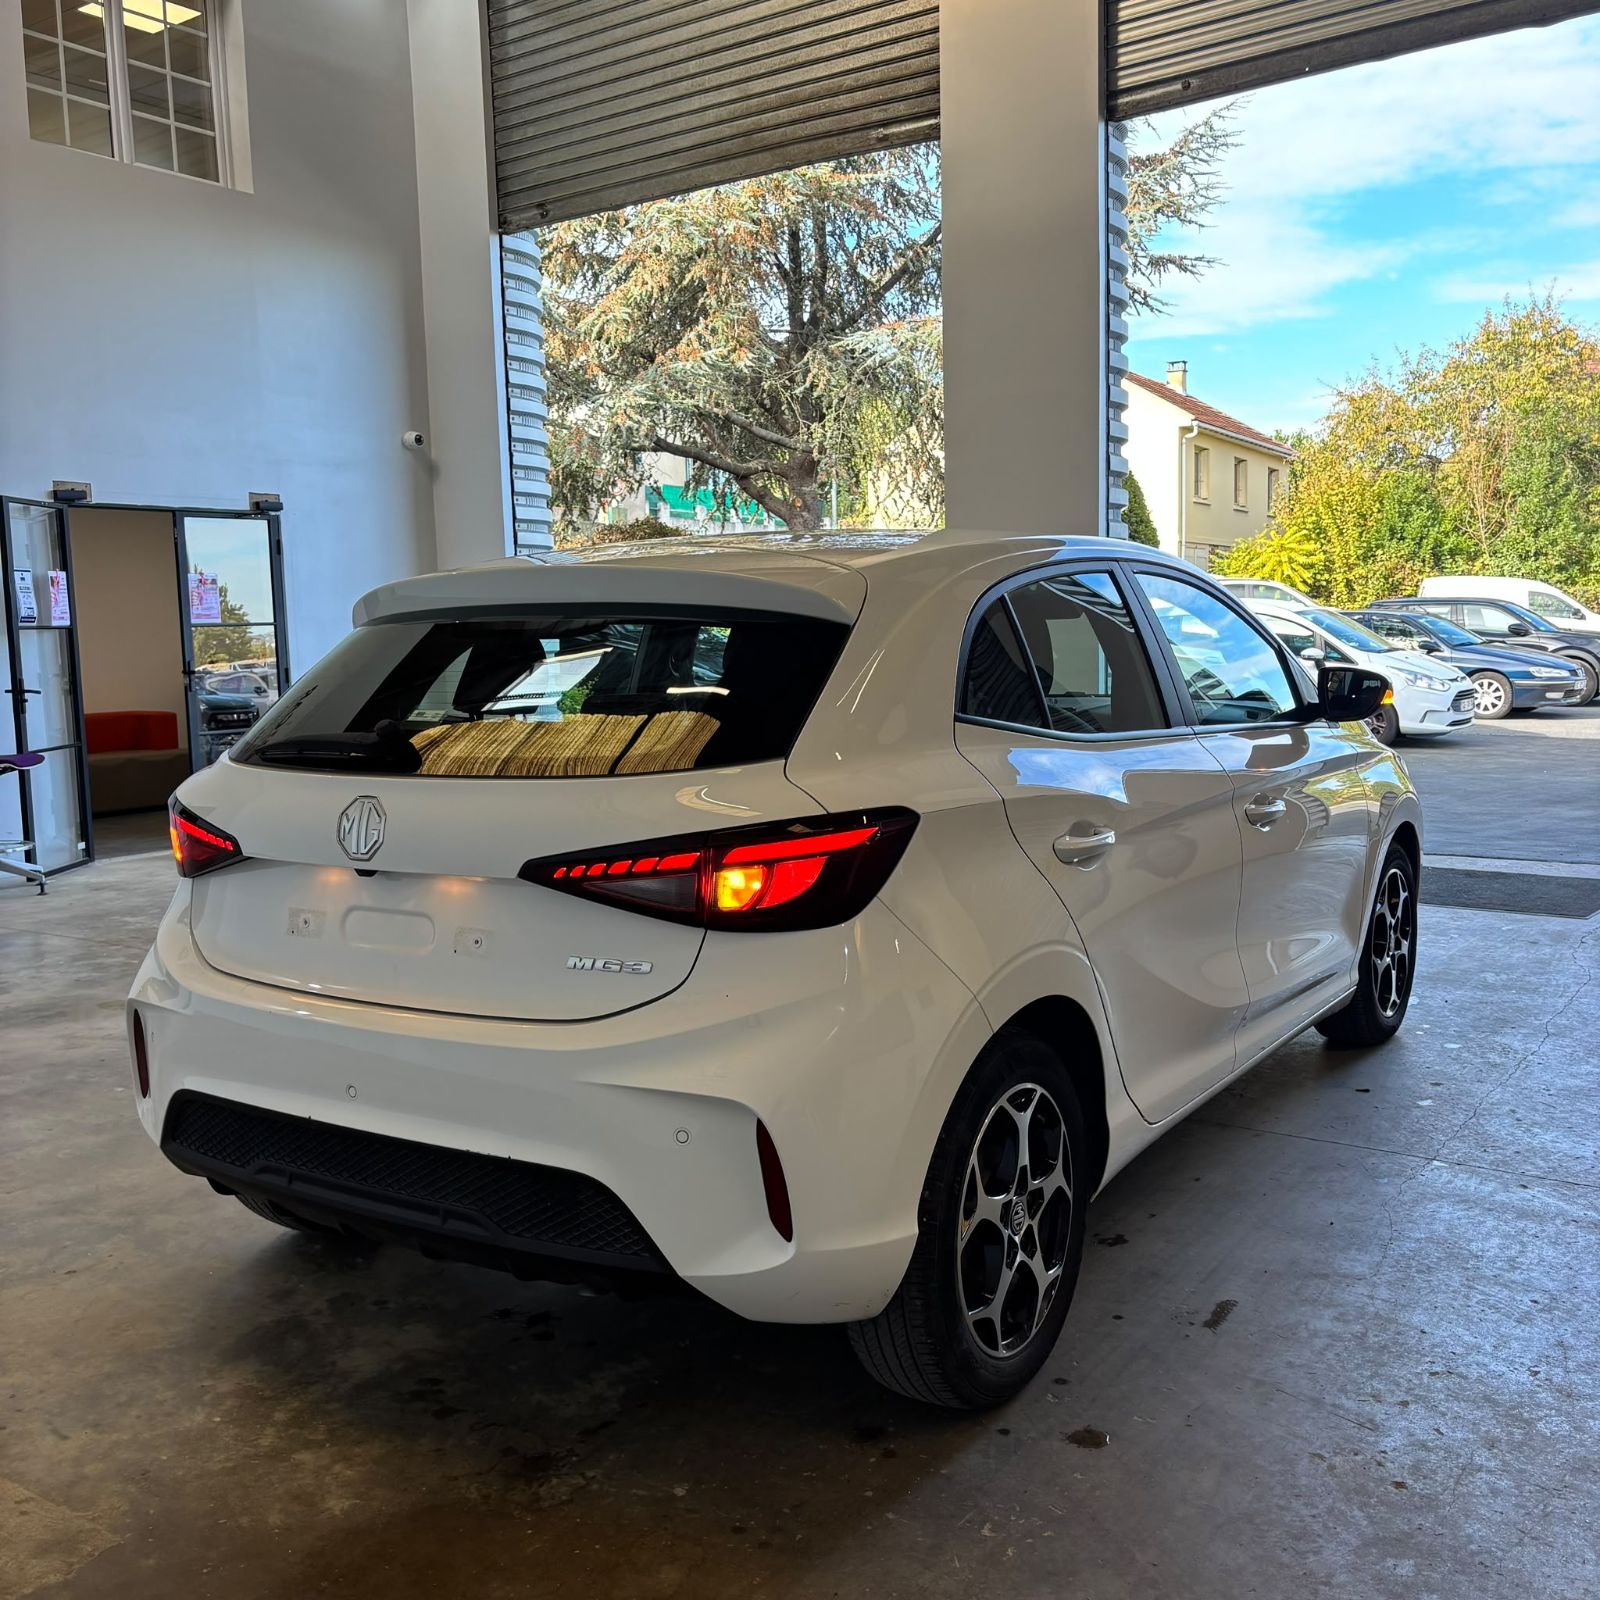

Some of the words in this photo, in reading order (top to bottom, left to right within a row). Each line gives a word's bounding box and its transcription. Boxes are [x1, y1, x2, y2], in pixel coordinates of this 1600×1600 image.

[340, 799, 382, 856] MG
[566, 955, 653, 975] MG3
[1012, 1203, 1025, 1232] MG
